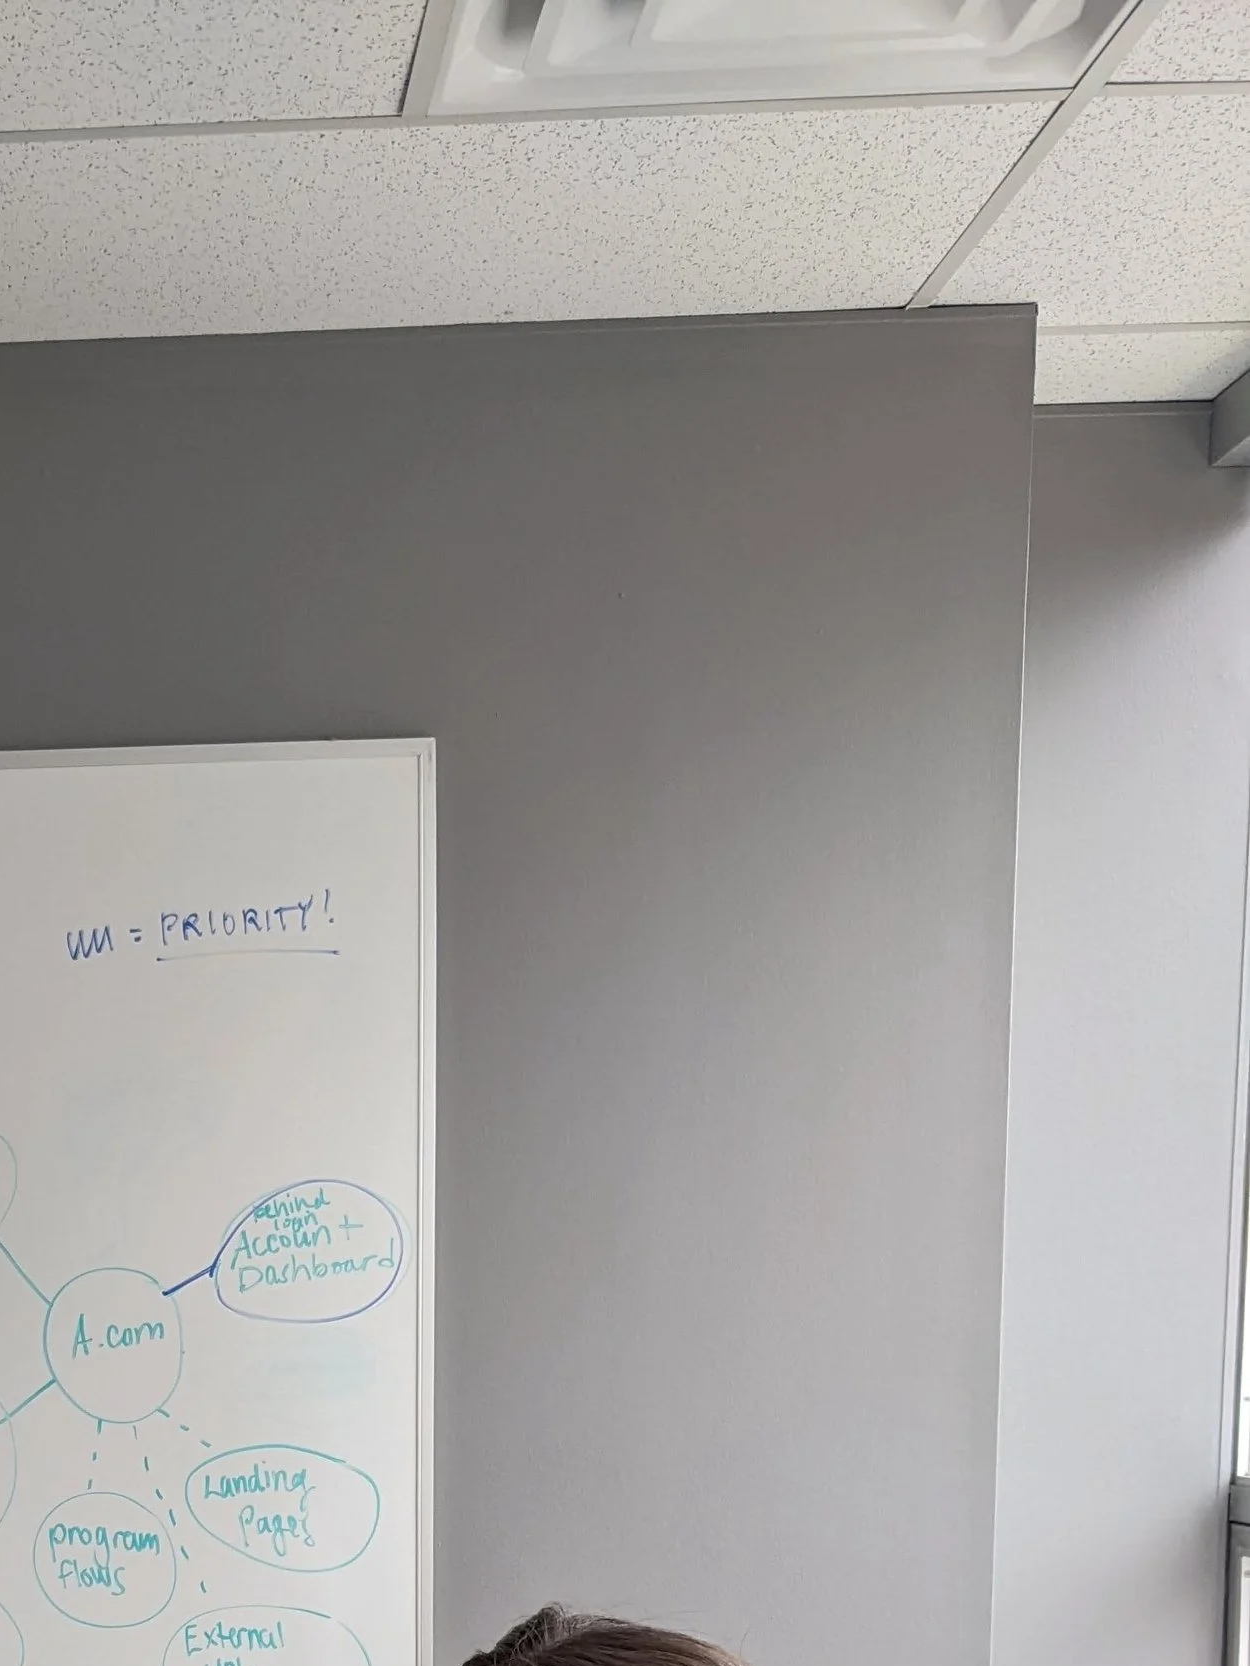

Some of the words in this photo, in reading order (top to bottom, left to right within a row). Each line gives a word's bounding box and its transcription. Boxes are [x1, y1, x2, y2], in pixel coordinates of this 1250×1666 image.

[160, 888, 337, 946] PRIORITY!
[238, 1236, 396, 1294] Dashboard
[71, 1313, 166, 1360] A.com
[183, 1619, 286, 1657] External
